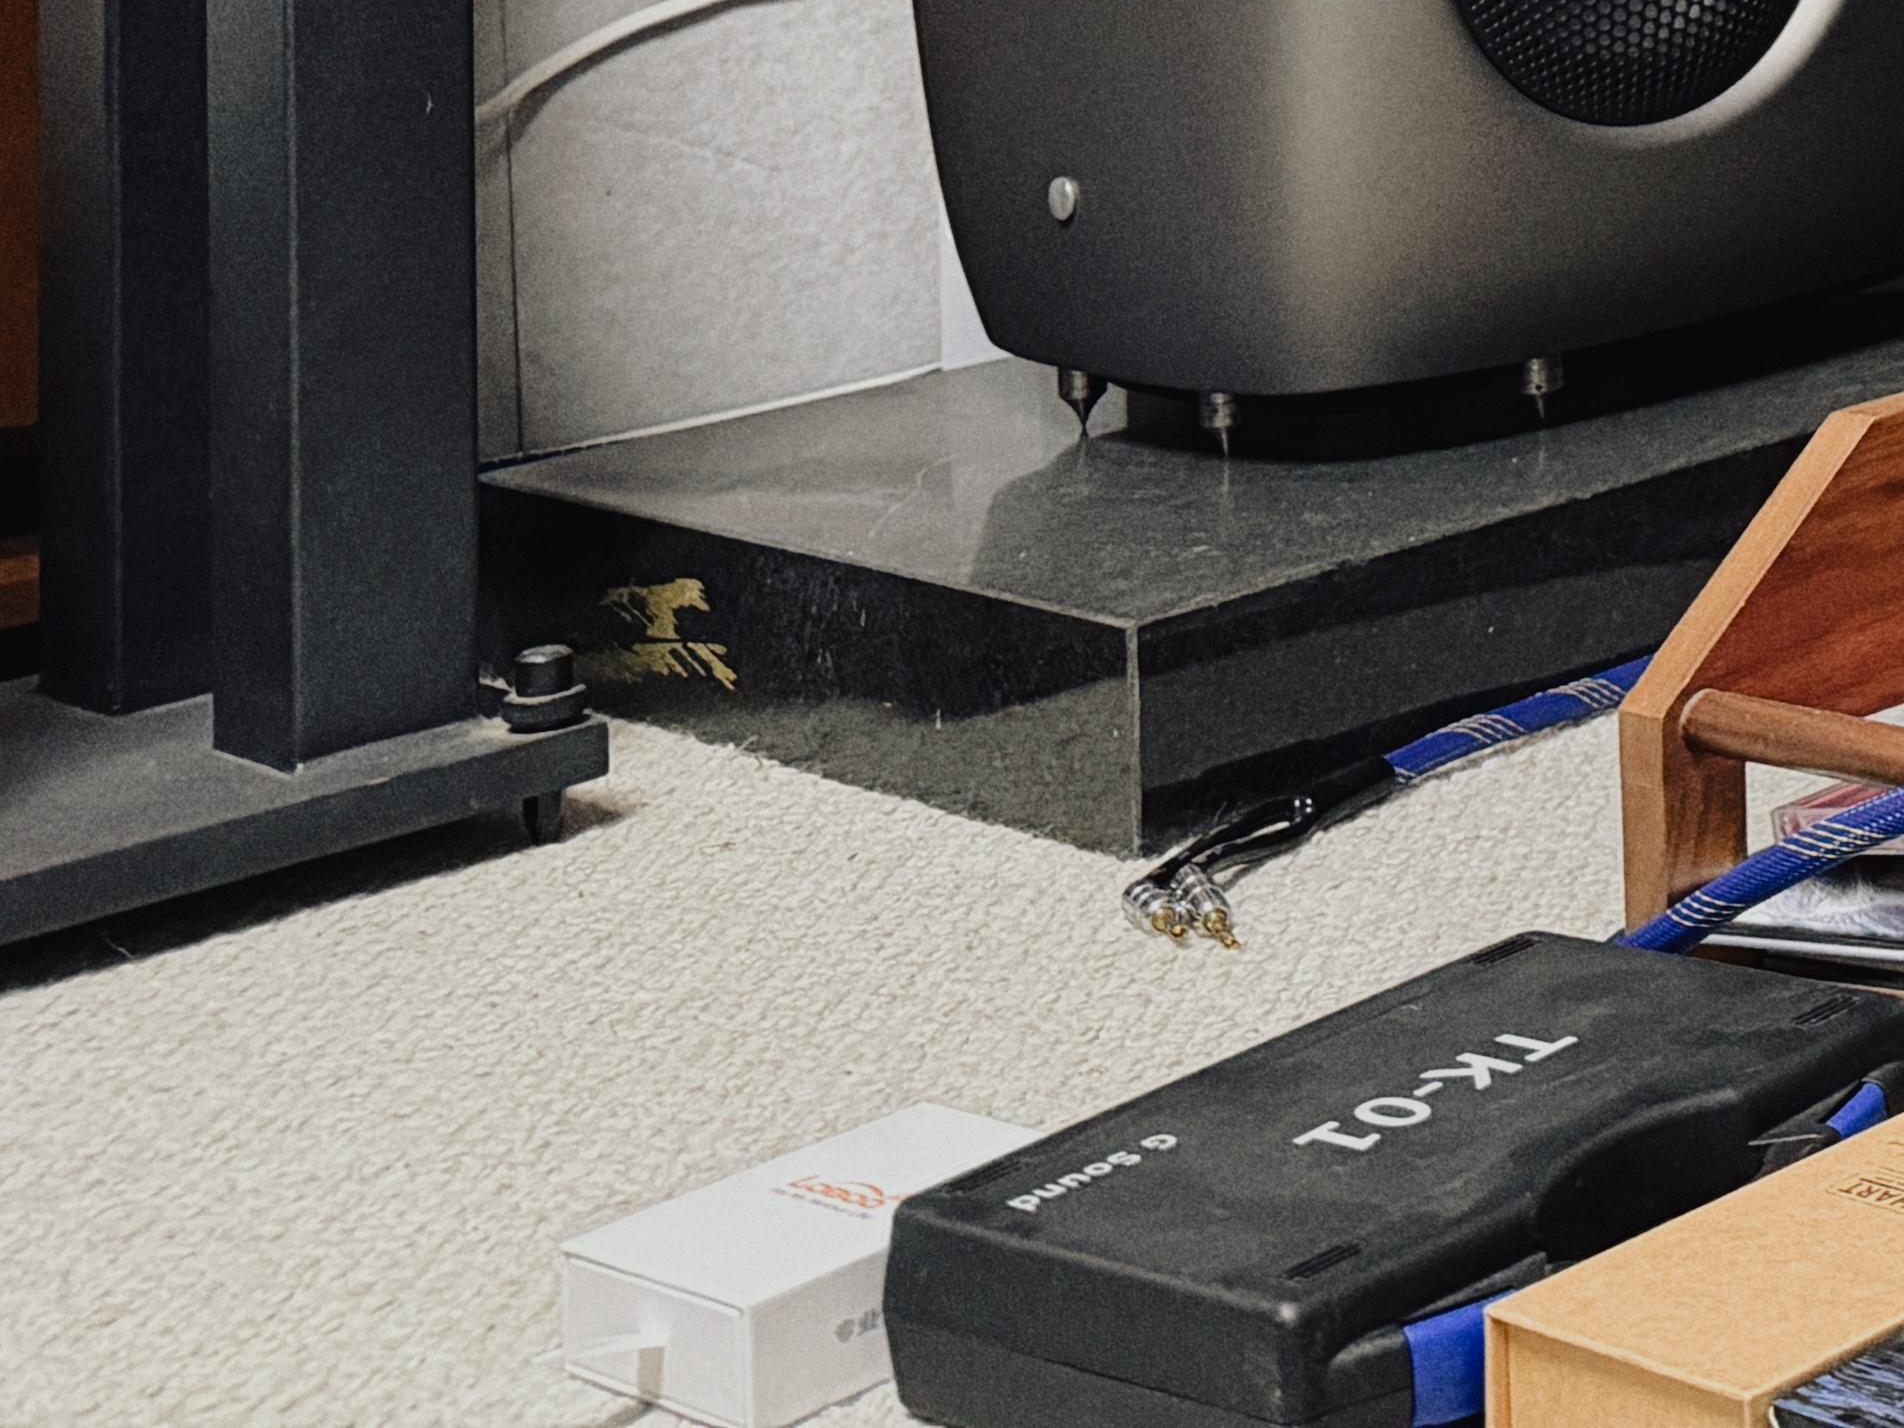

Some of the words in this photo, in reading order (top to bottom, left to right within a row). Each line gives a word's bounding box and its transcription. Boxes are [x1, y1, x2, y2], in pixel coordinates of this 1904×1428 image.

[1293, 1030, 1579, 1152] TK-01
[1139, 1131, 1178, 1153] G
[1005, 1148, 1142, 1214] Sound
